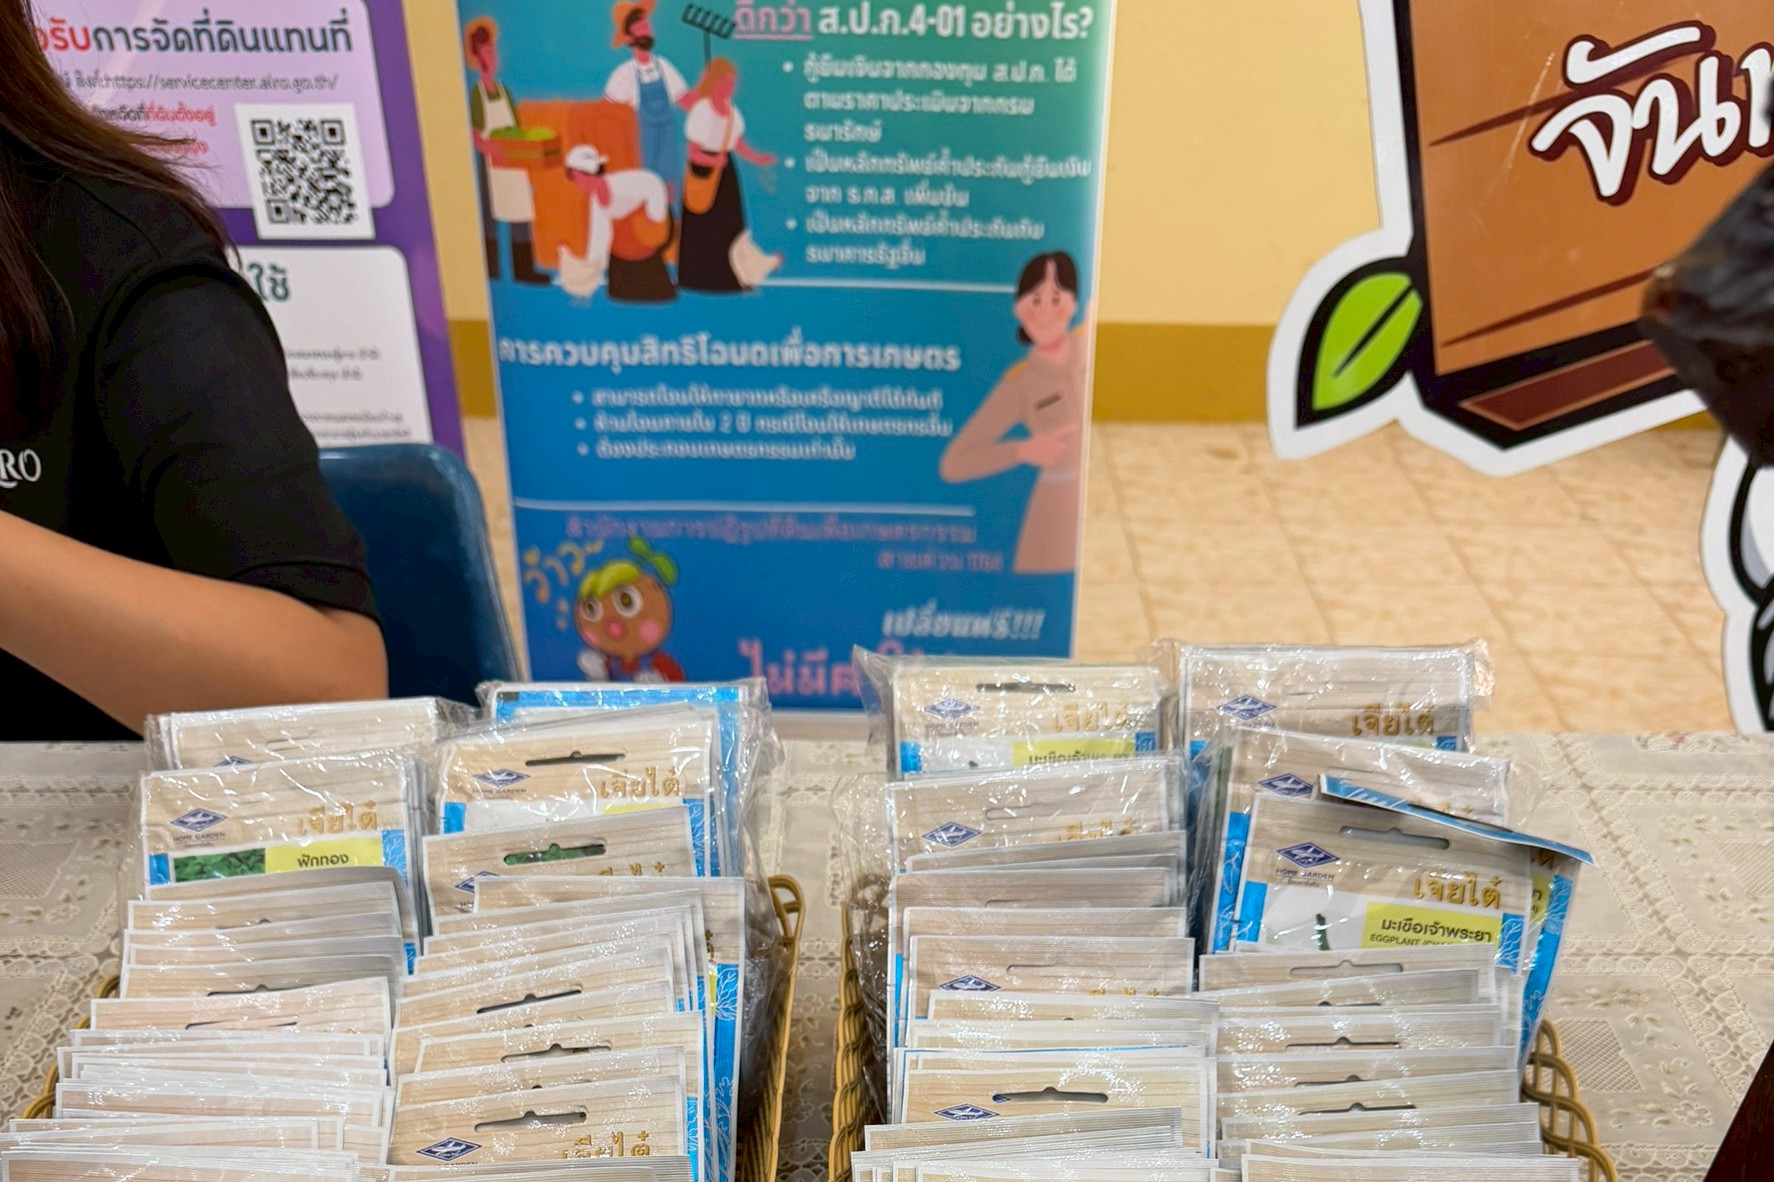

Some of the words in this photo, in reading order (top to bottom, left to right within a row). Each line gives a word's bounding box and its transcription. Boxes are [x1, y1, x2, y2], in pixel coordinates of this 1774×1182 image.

[818, 4, 966, 37] ส.ป.ก.4-01
[297, 853, 350, 868] ฟักทอง
[1369, 934, 1421, 947] EGGPLANT
